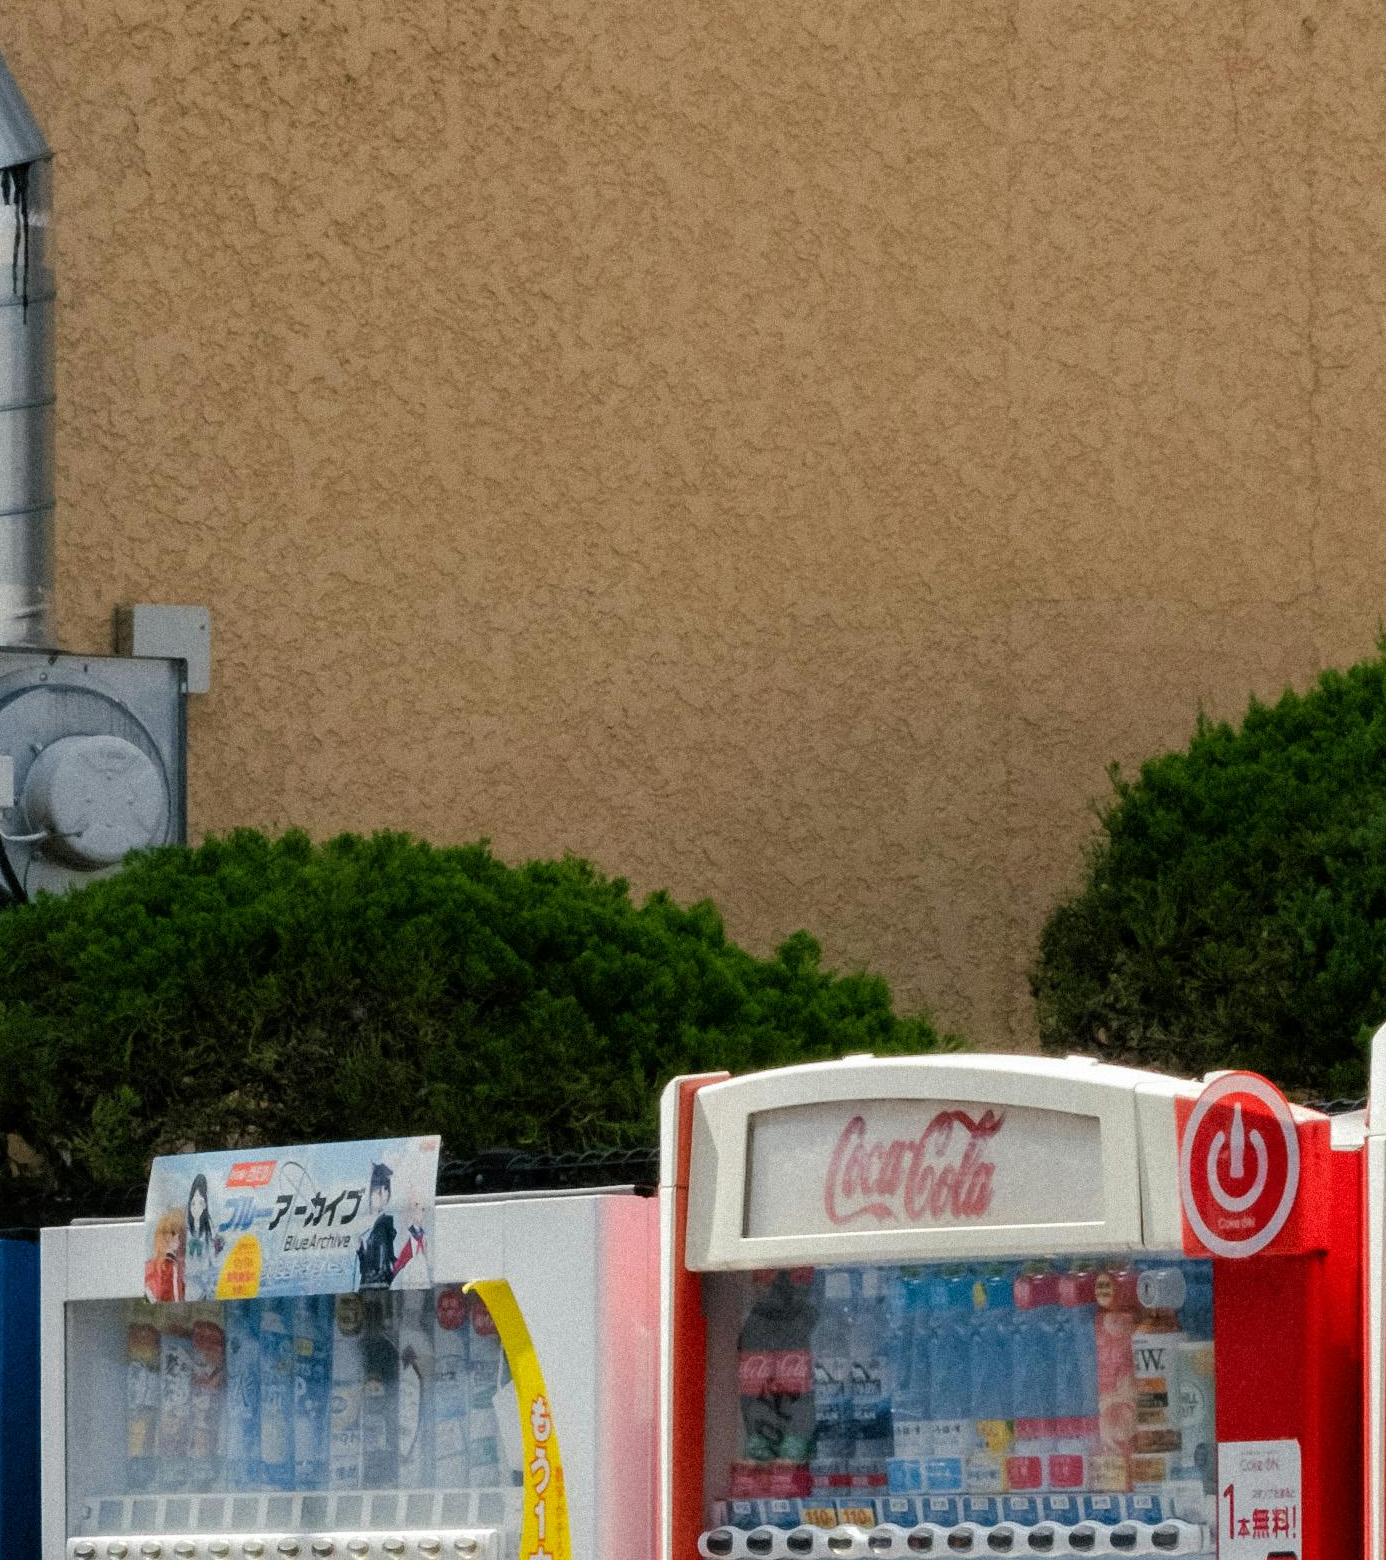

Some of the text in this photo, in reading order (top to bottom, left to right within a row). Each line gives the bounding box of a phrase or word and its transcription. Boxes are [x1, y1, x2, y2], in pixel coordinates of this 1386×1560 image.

[219, 1188, 365, 1231] ブルーアーカイブ
